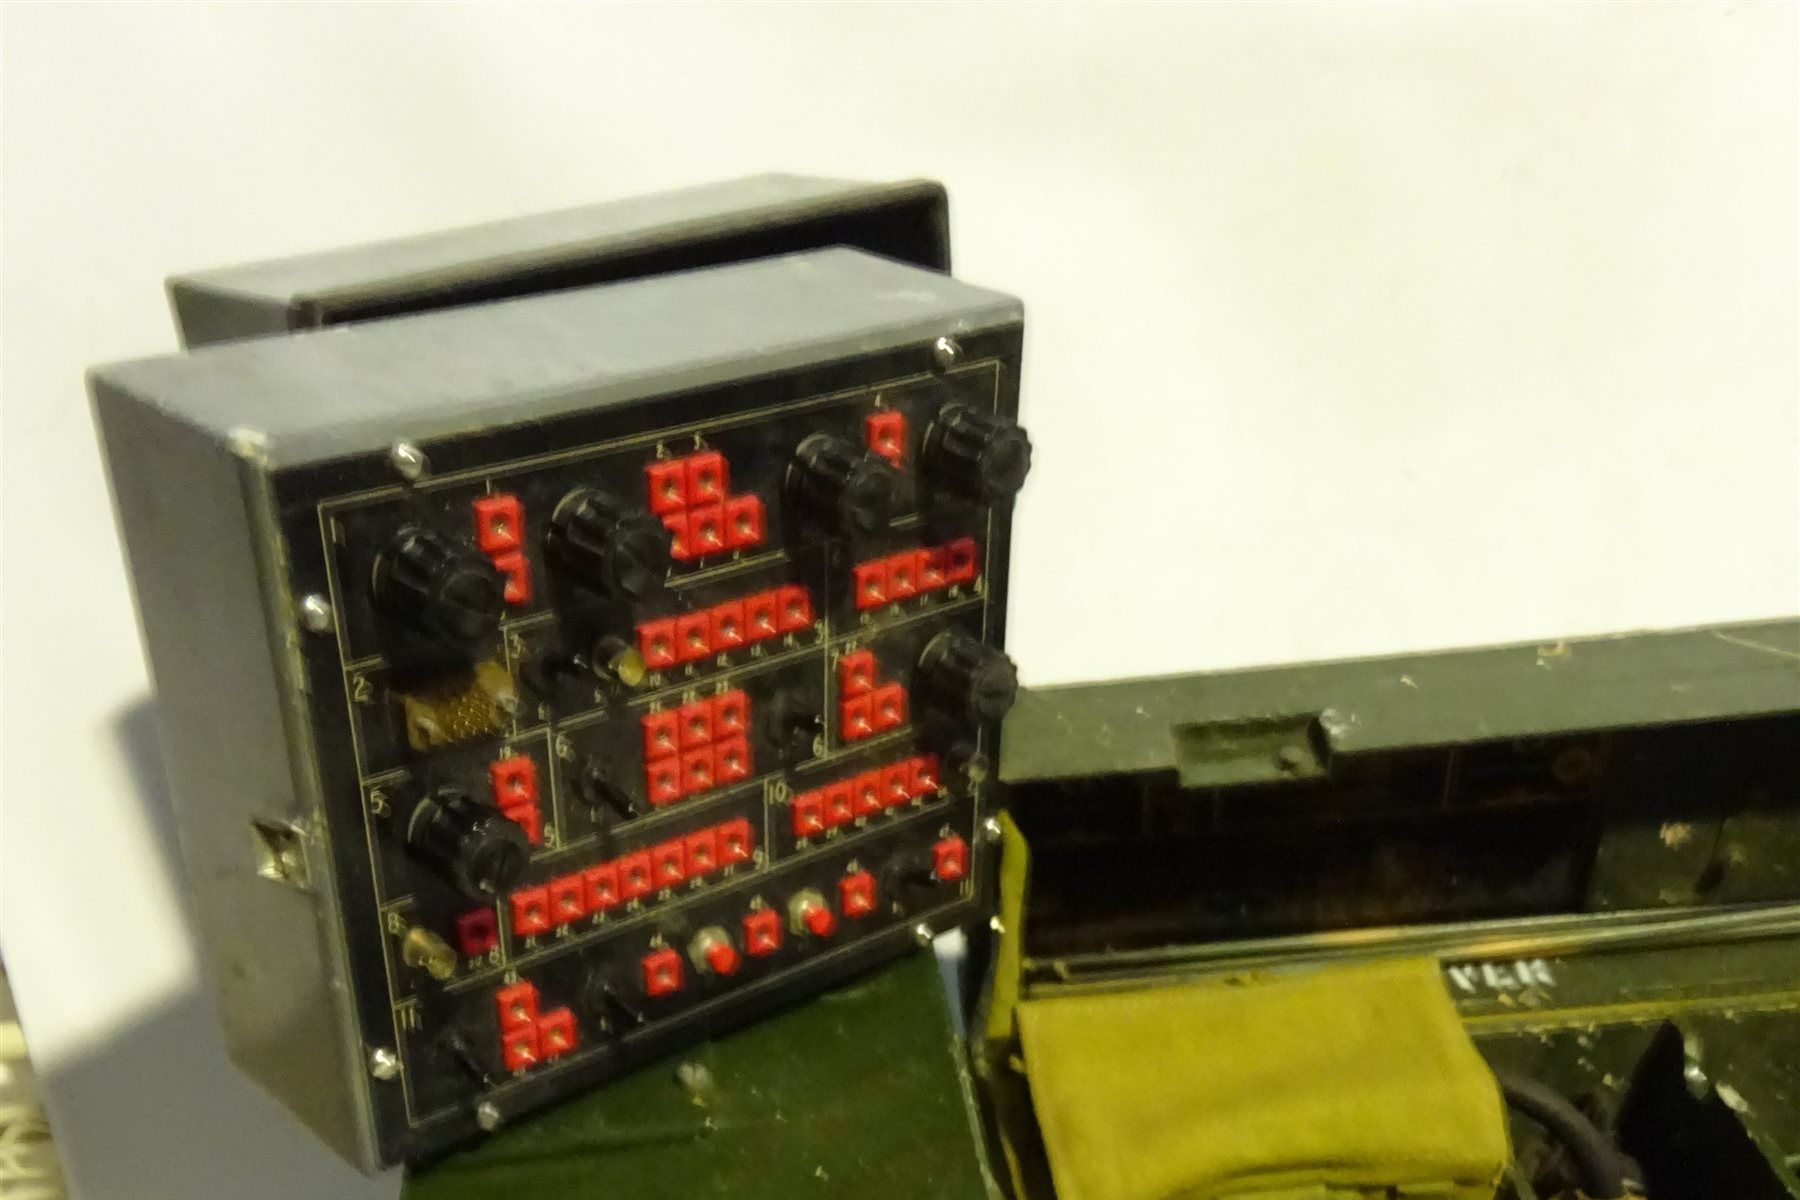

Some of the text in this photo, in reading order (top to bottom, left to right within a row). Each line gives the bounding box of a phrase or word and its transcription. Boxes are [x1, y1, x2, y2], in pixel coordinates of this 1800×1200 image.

[352, 673, 368, 702] 2
[555, 733, 572, 759] 6
[369, 785, 385, 816] 5
[767, 779, 788, 805] 10
[388, 912, 402, 935] 8
[400, 1007, 416, 1031] 11
